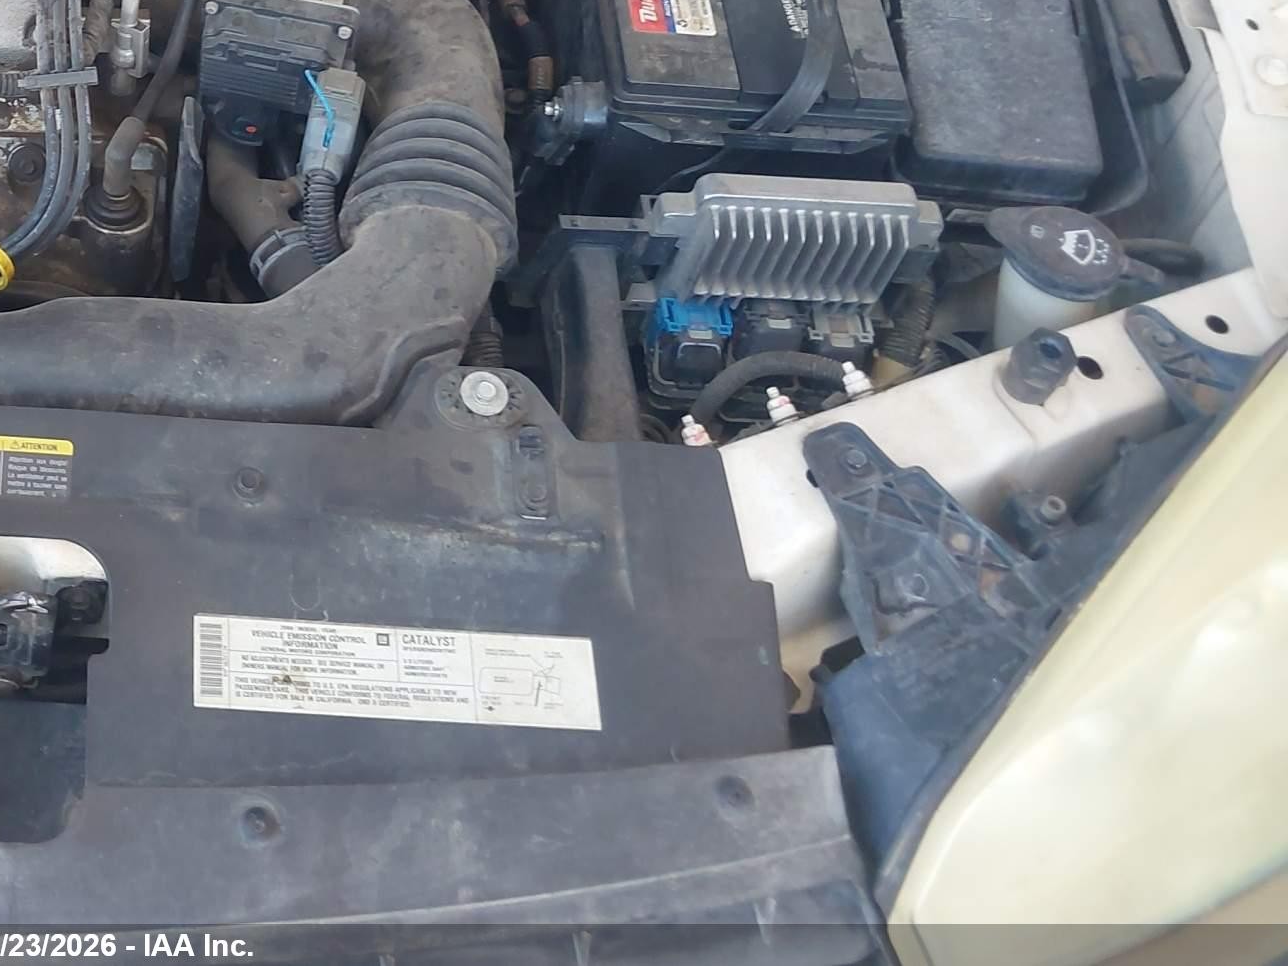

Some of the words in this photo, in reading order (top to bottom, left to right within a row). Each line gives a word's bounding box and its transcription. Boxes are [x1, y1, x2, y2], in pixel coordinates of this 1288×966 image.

[21, 442, 58, 451] ATTENTION
[252, 630, 283, 639] VEHICLE
[287, 632, 326, 642] EMISSION
[329, 634, 366, 644] CONTROL
[402, 634, 456, 647] CATALYST
[283, 641, 338, 649] INFORMATION
